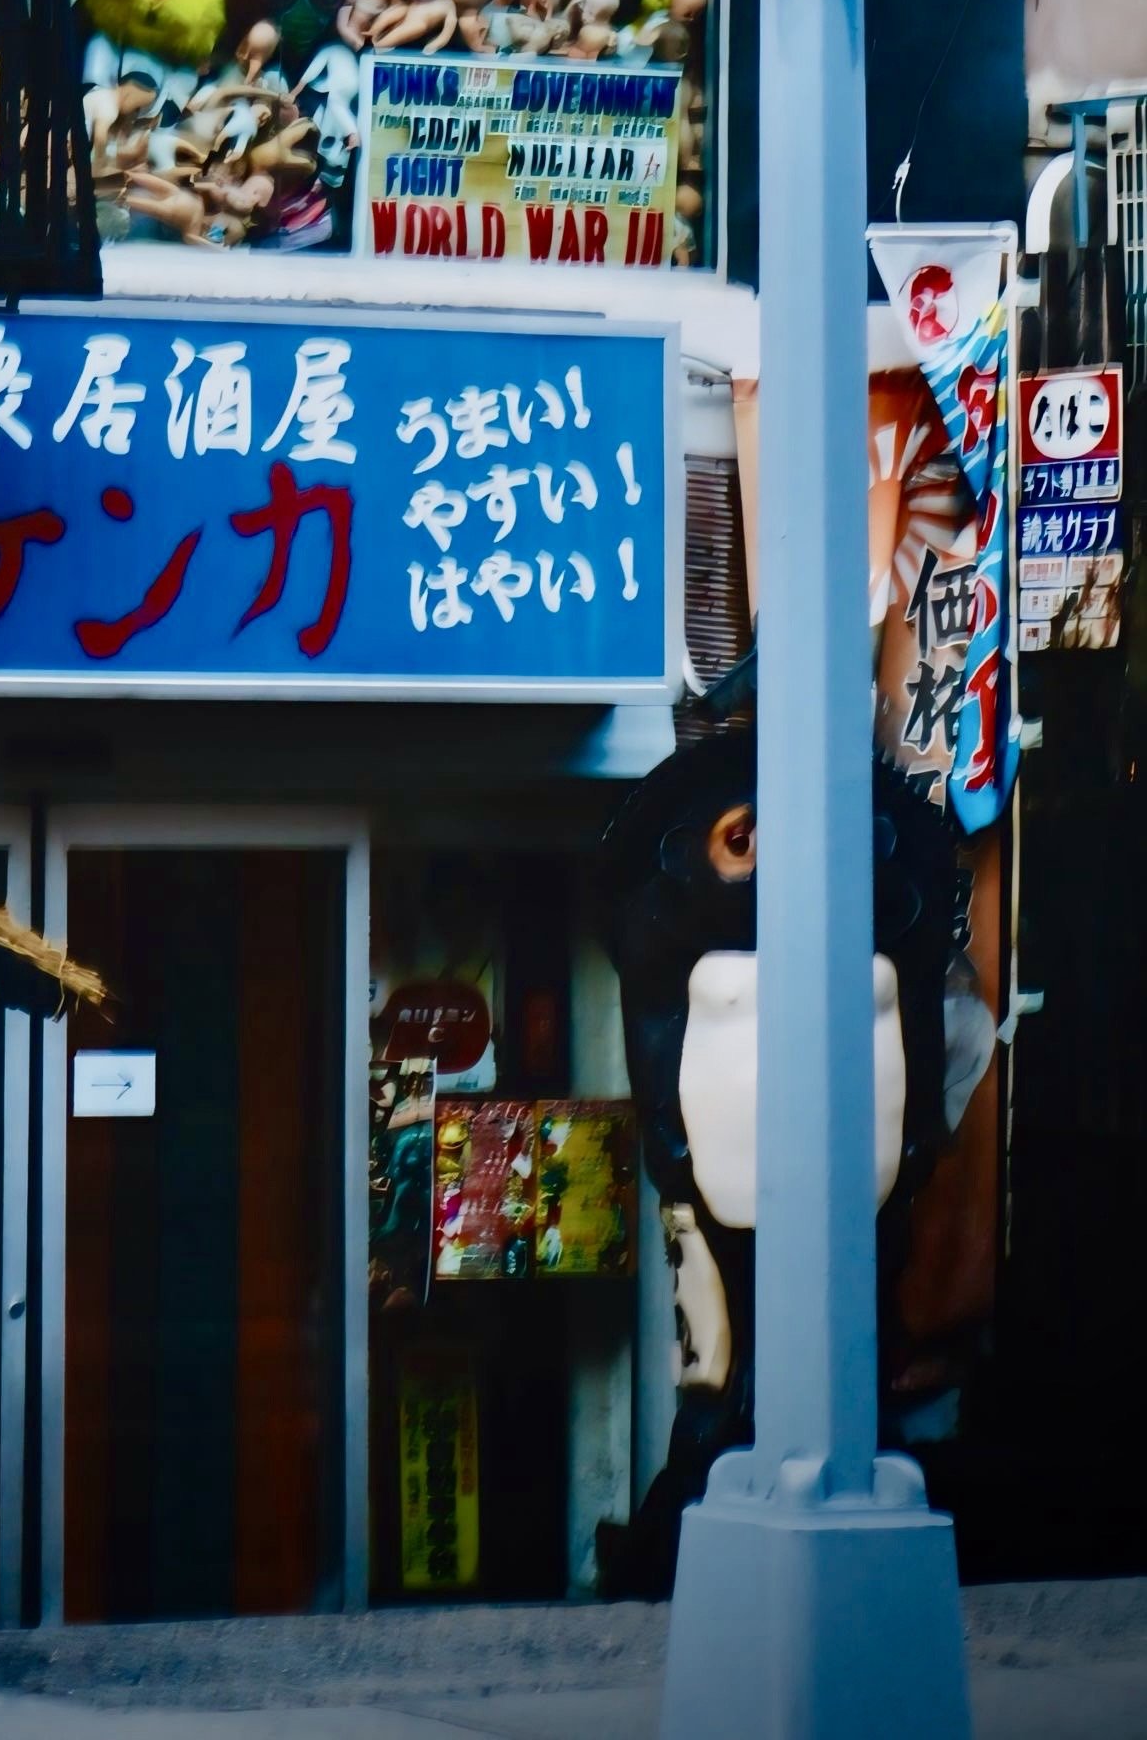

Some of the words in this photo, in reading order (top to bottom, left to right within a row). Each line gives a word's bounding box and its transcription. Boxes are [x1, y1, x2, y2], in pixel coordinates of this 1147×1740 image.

[372, 65, 459, 107] PUNKS
[507, 143, 635, 181] NUCLEAR
[371, 201, 506, 259] WORLD
[525, 204, 609, 266] WAR
[396, 364, 592, 475] うまい!
[406, 536, 639, 633] はやい!
